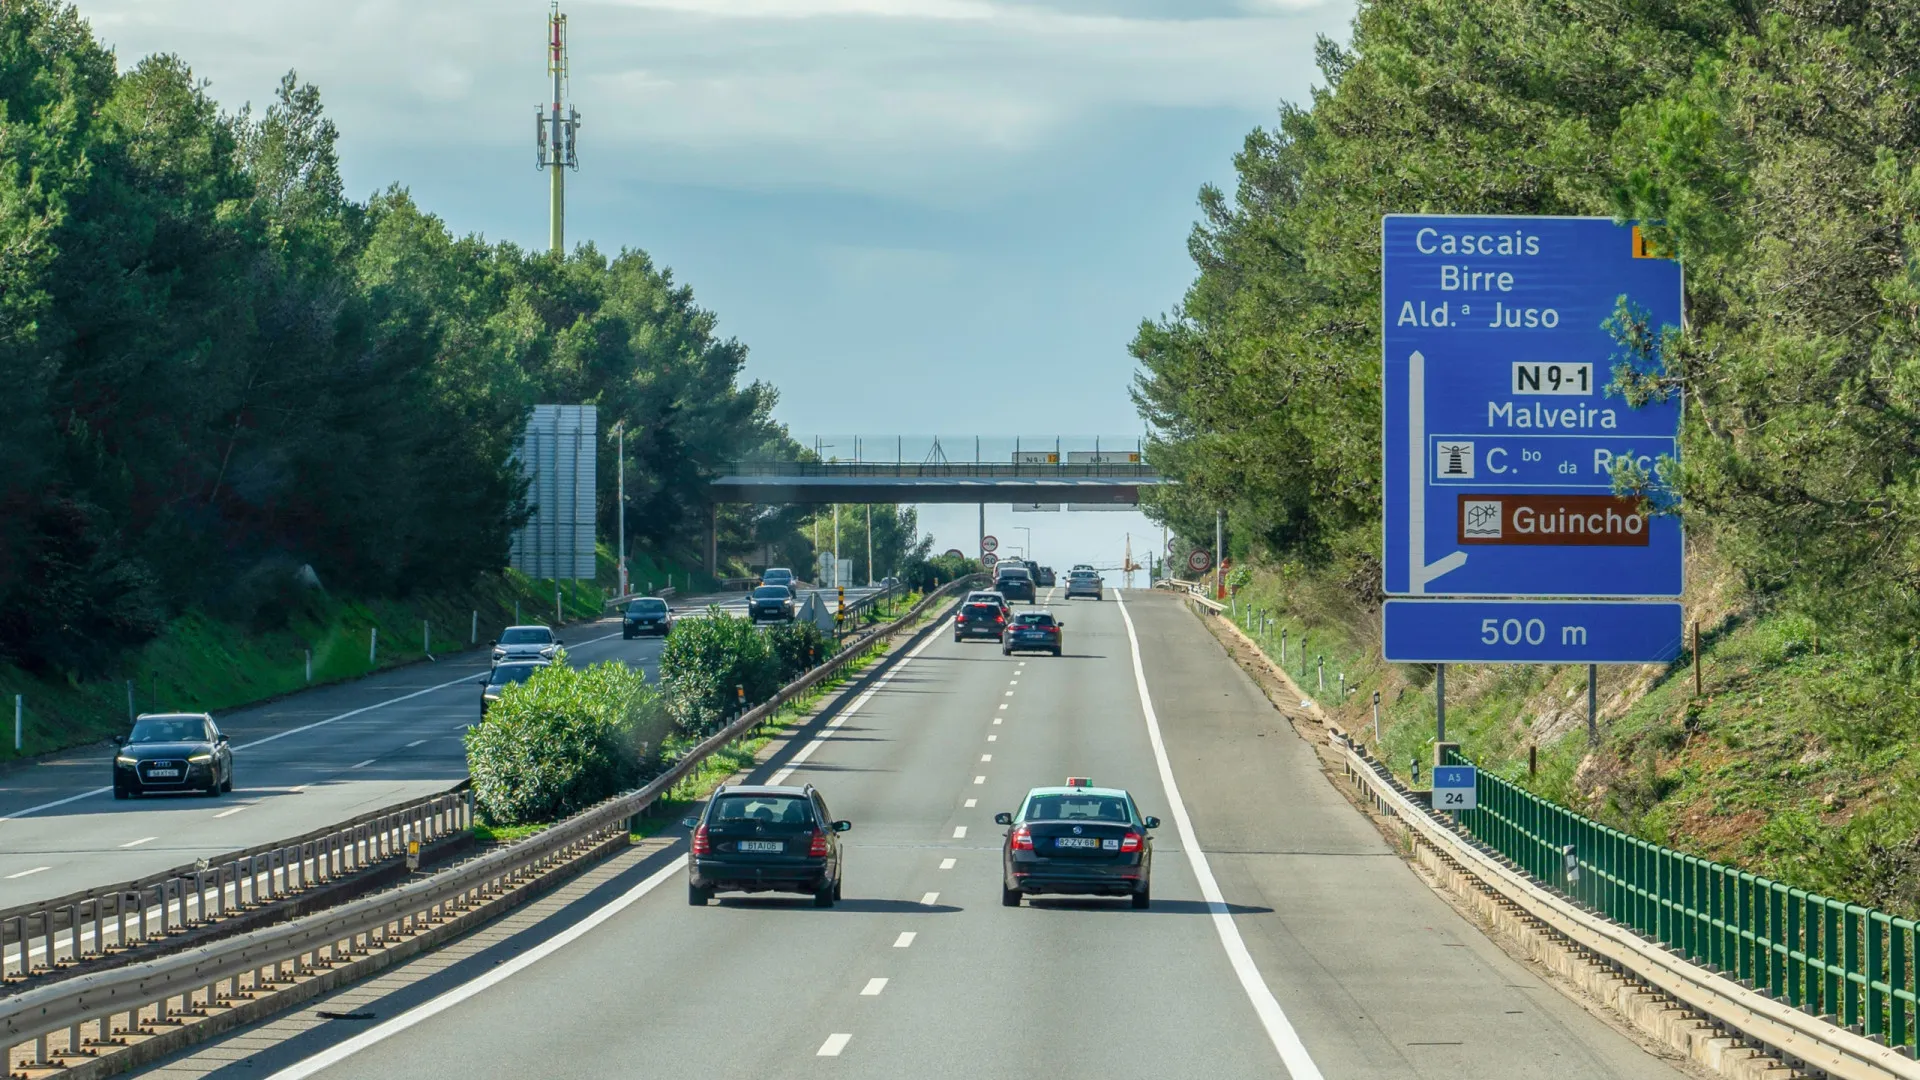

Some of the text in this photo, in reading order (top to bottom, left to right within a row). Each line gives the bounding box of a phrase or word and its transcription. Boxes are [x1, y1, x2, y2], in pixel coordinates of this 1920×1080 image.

[1416, 227, 1540, 256] Cascais
[1440, 265, 1514, 292] Birre
[1489, 302, 1559, 328] Juso
[1488, 401, 1617, 428] Malveira
[1558, 461, 1578, 474] da
[1512, 506, 1643, 534] Guincho
[1192, 557, 1208, 565] 100
[1481, 618, 1587, 645] 500 m
[1448, 774, 1462, 782] A5
[1445, 793, 1463, 804] 24
